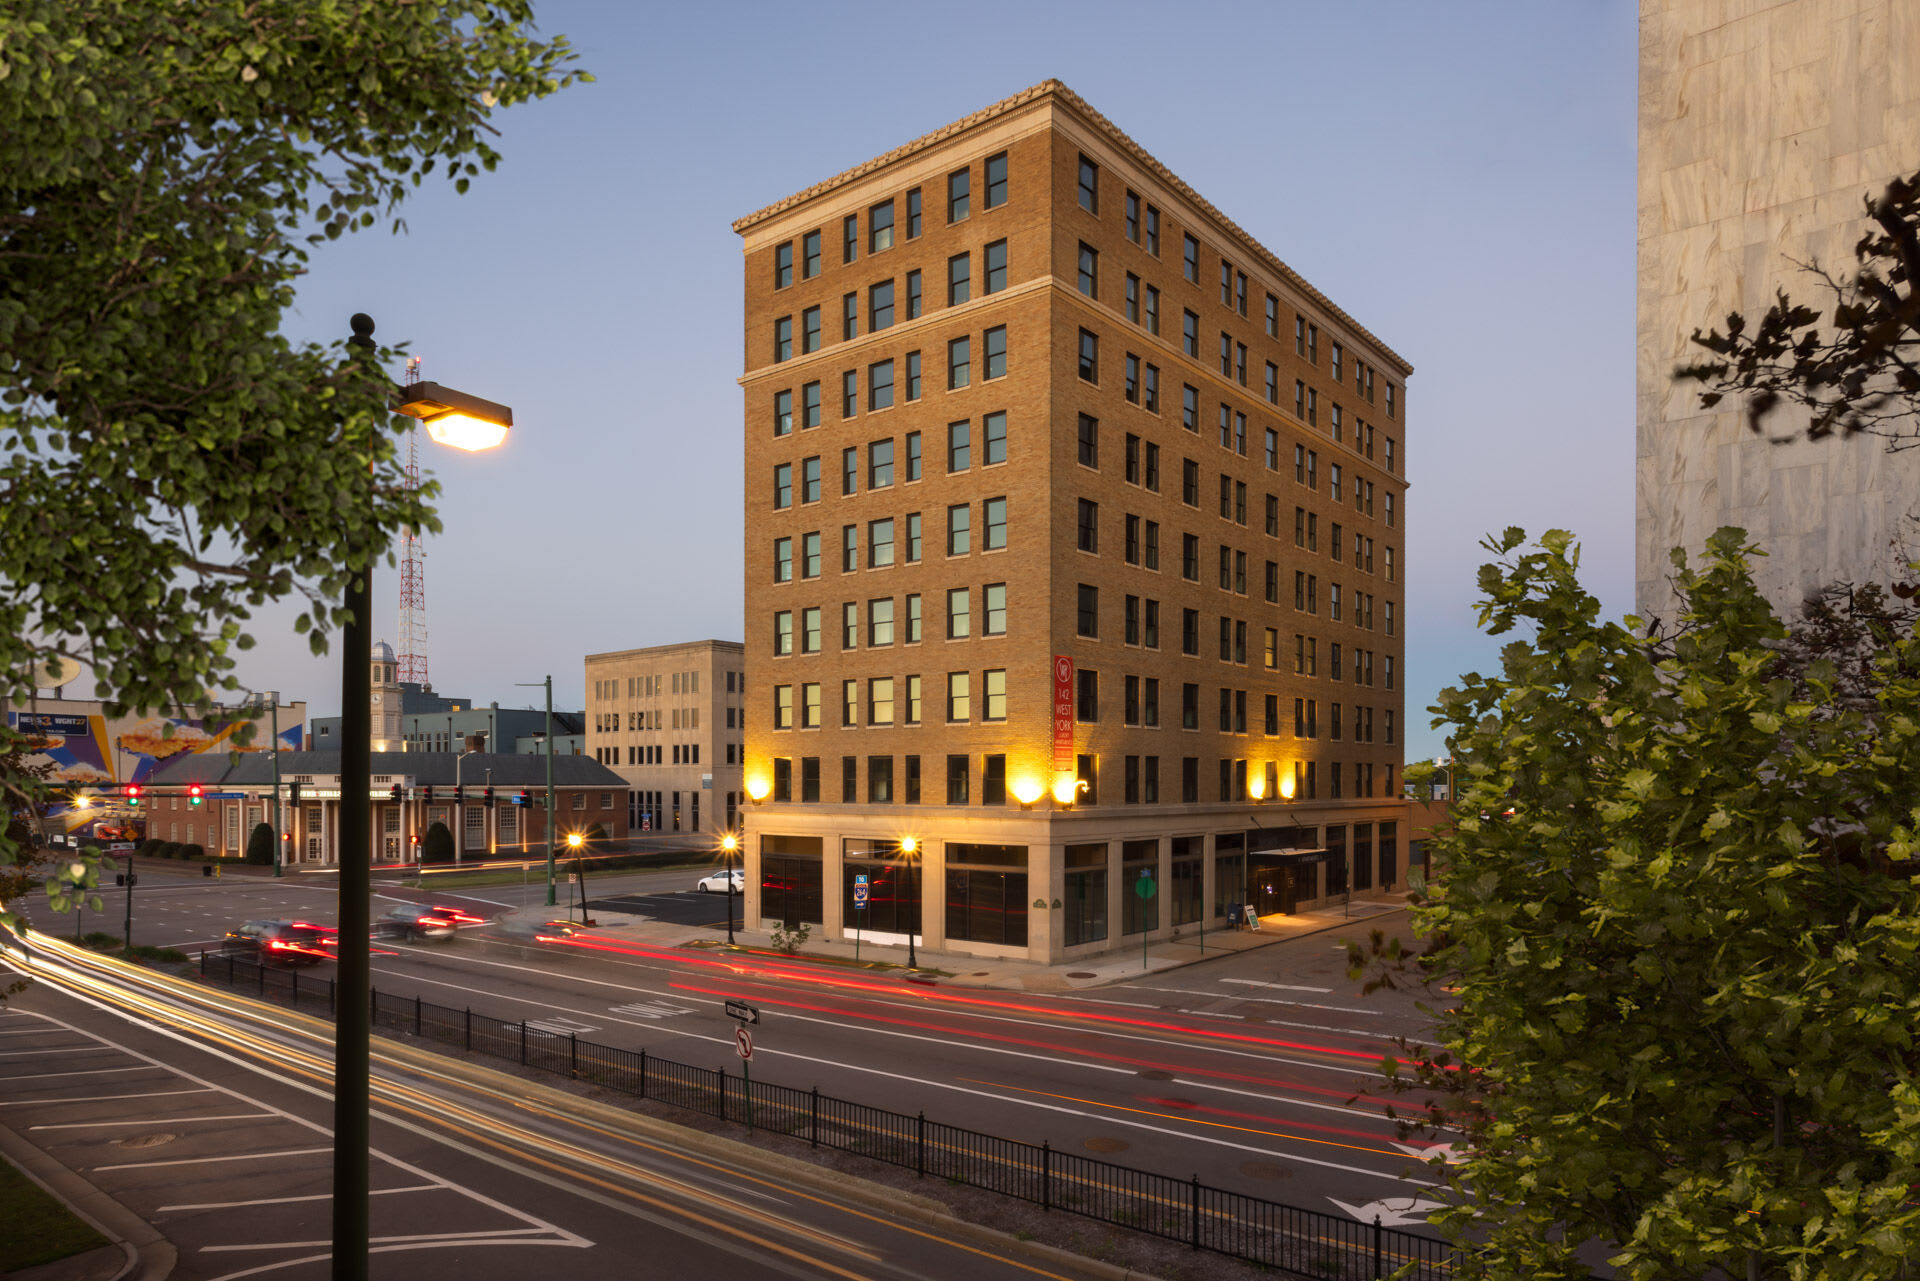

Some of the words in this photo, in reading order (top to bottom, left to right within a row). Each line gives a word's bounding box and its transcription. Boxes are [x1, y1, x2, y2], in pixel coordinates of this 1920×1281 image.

[1058, 688, 1069, 699] 142
[1056, 704, 1072, 716] WEST
[1056, 720, 1071, 731] YORK
